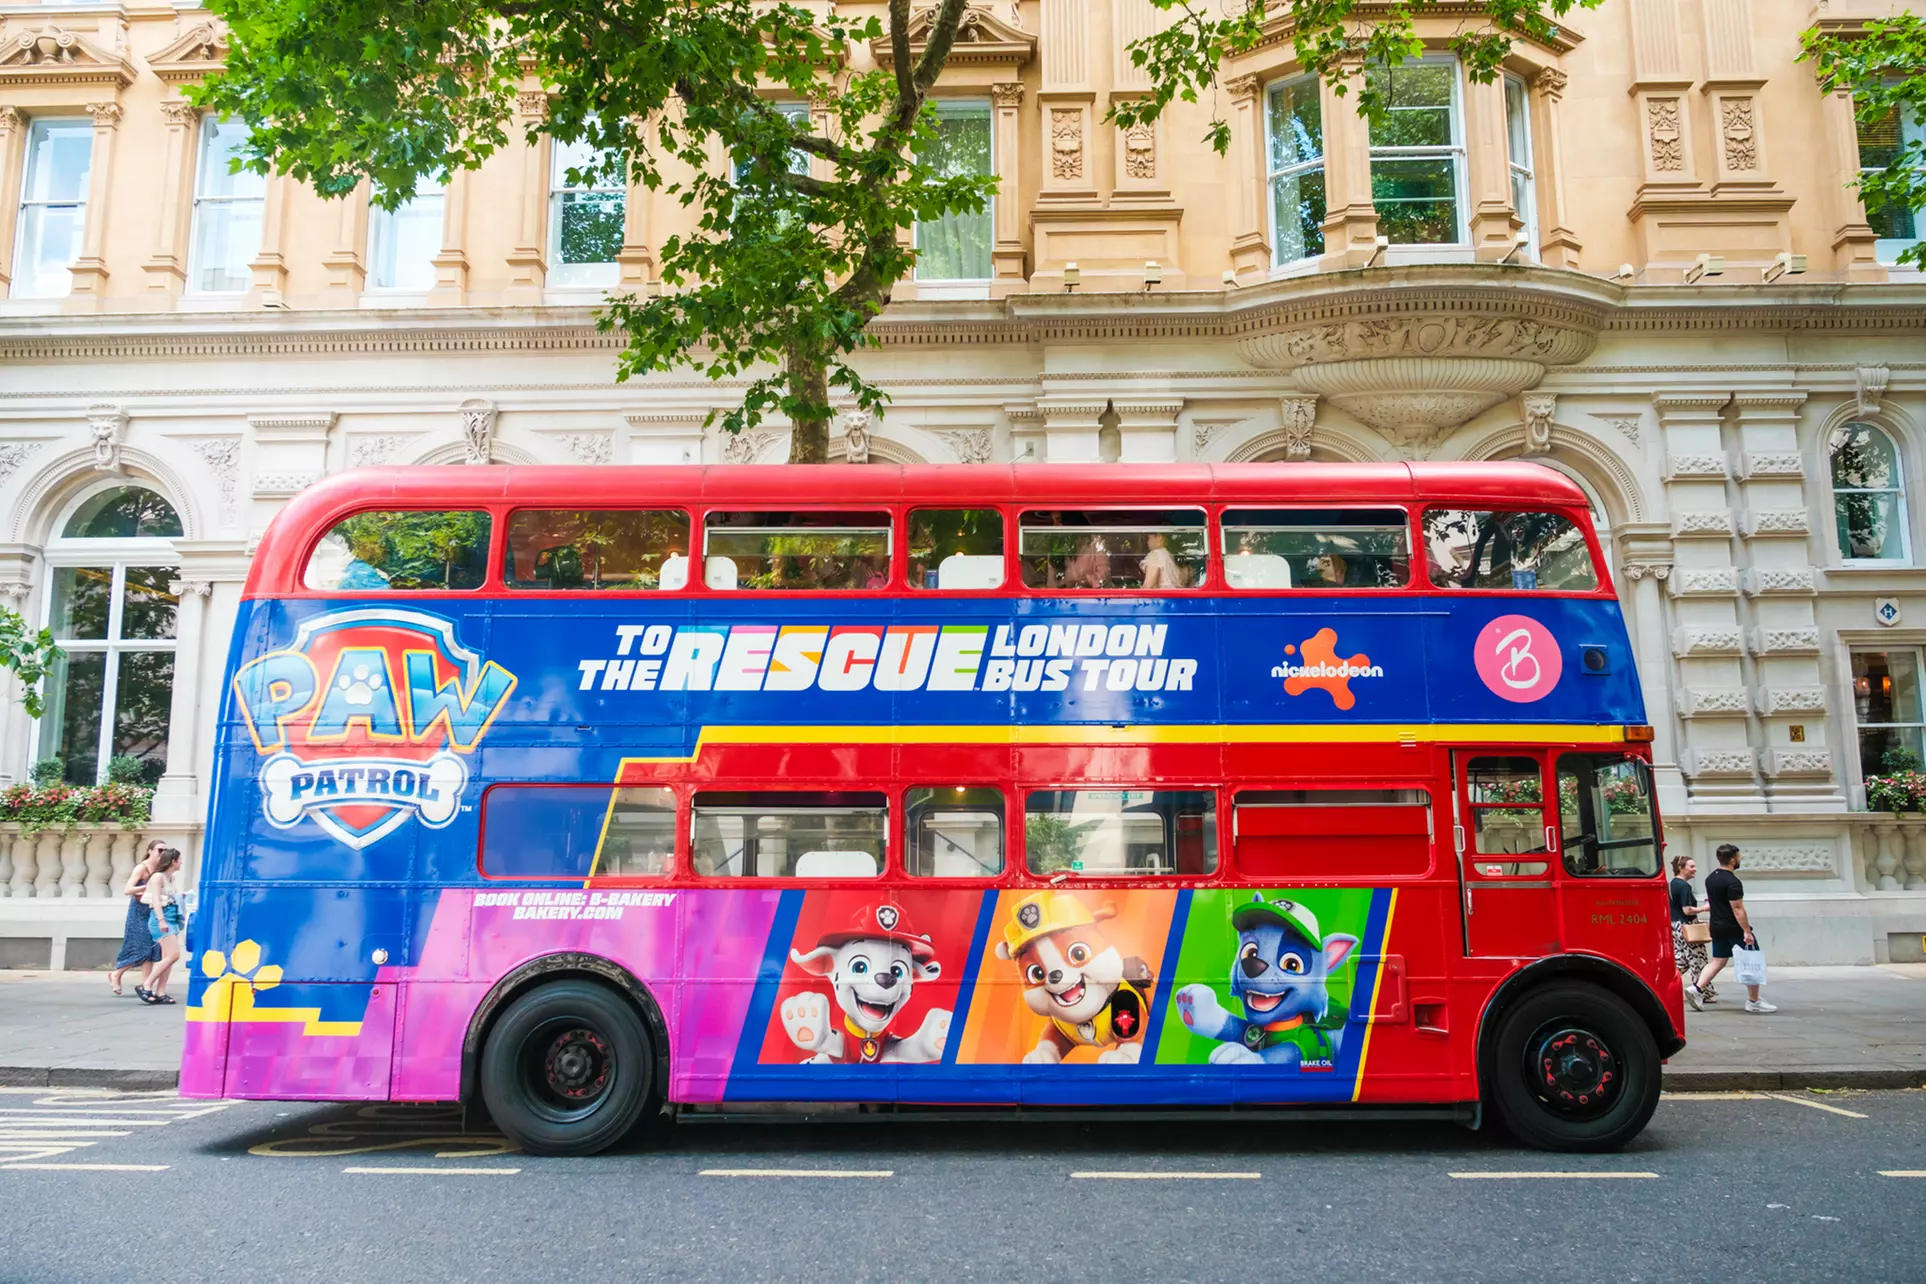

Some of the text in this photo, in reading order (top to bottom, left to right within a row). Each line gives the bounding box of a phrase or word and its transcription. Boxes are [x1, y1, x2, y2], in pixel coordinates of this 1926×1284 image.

[615, 624, 673, 656] TO
[990, 624, 1168, 656] LONDON
[658, 625, 989, 692] RESCUE
[1271, 660, 1384, 678] nickelodeon
[1495, 628, 1541, 689] B
[577, 659, 663, 691] THE
[981, 659, 1198, 692] BUS TOUR
[234, 646, 518, 756] PAW
[290, 768, 440, 801] PATROL
[473, 892, 677, 907] BOOK ONLINE: B-BAKERY
[512, 906, 624, 920] BAKERY.COM
[1591, 913, 1648, 925] RML 2404
[1300, 1059, 1333, 1067] BRAKE OIL
